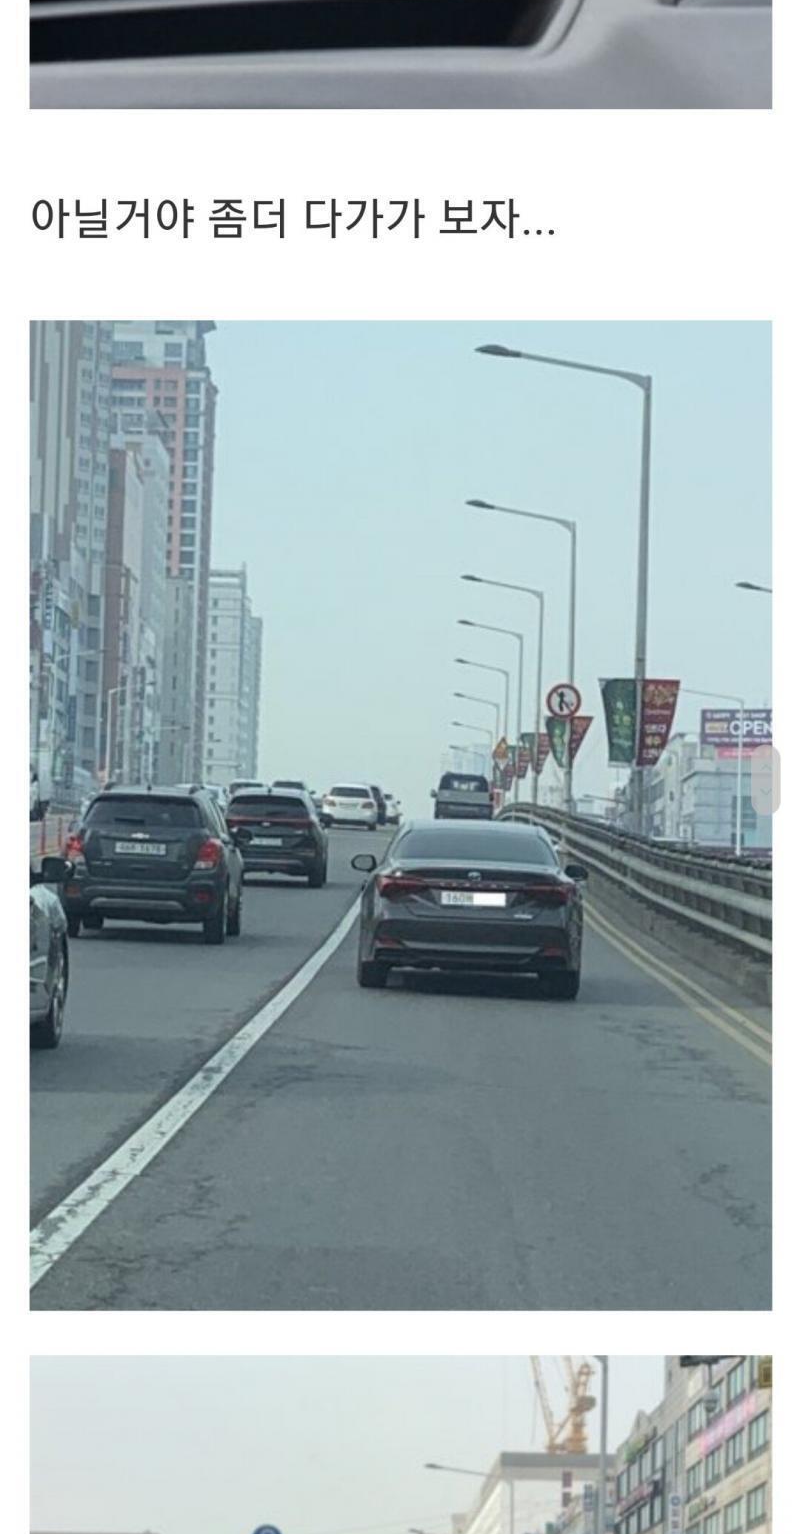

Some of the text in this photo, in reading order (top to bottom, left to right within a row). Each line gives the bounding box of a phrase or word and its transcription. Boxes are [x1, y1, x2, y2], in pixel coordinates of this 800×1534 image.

[31, 198, 555, 239] 아닐거야 좀더 다가가 보자...
[729, 720, 773, 736] OPEN
